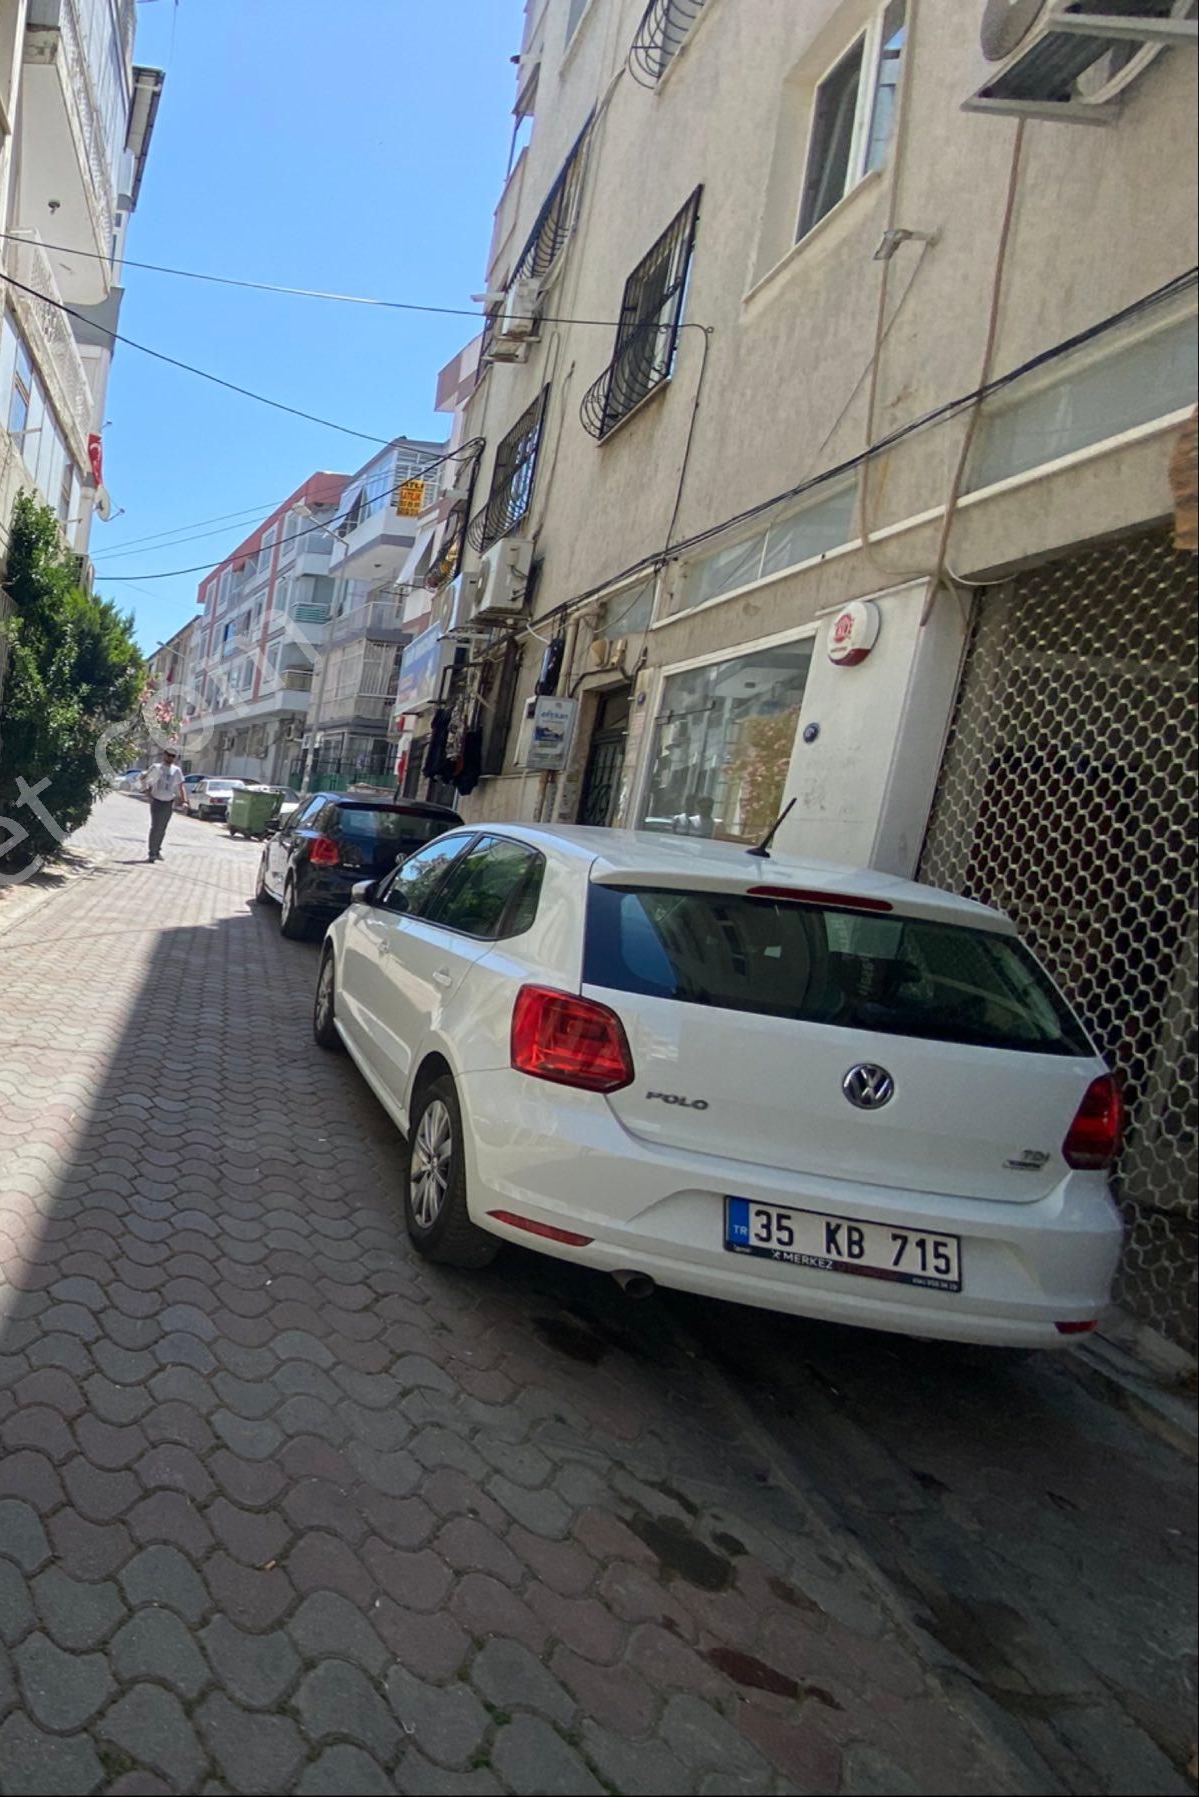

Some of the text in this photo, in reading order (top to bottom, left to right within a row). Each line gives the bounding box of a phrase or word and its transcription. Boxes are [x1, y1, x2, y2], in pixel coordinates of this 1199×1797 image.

[645, 1091, 709, 1110] POLO
[733, 1224, 748, 1236] TR
[754, 1209, 794, 1247] 35
[825, 1221, 864, 1259] KB
[890, 1232, 951, 1276] 715
[783, 1252, 834, 1270] MERKEZ
